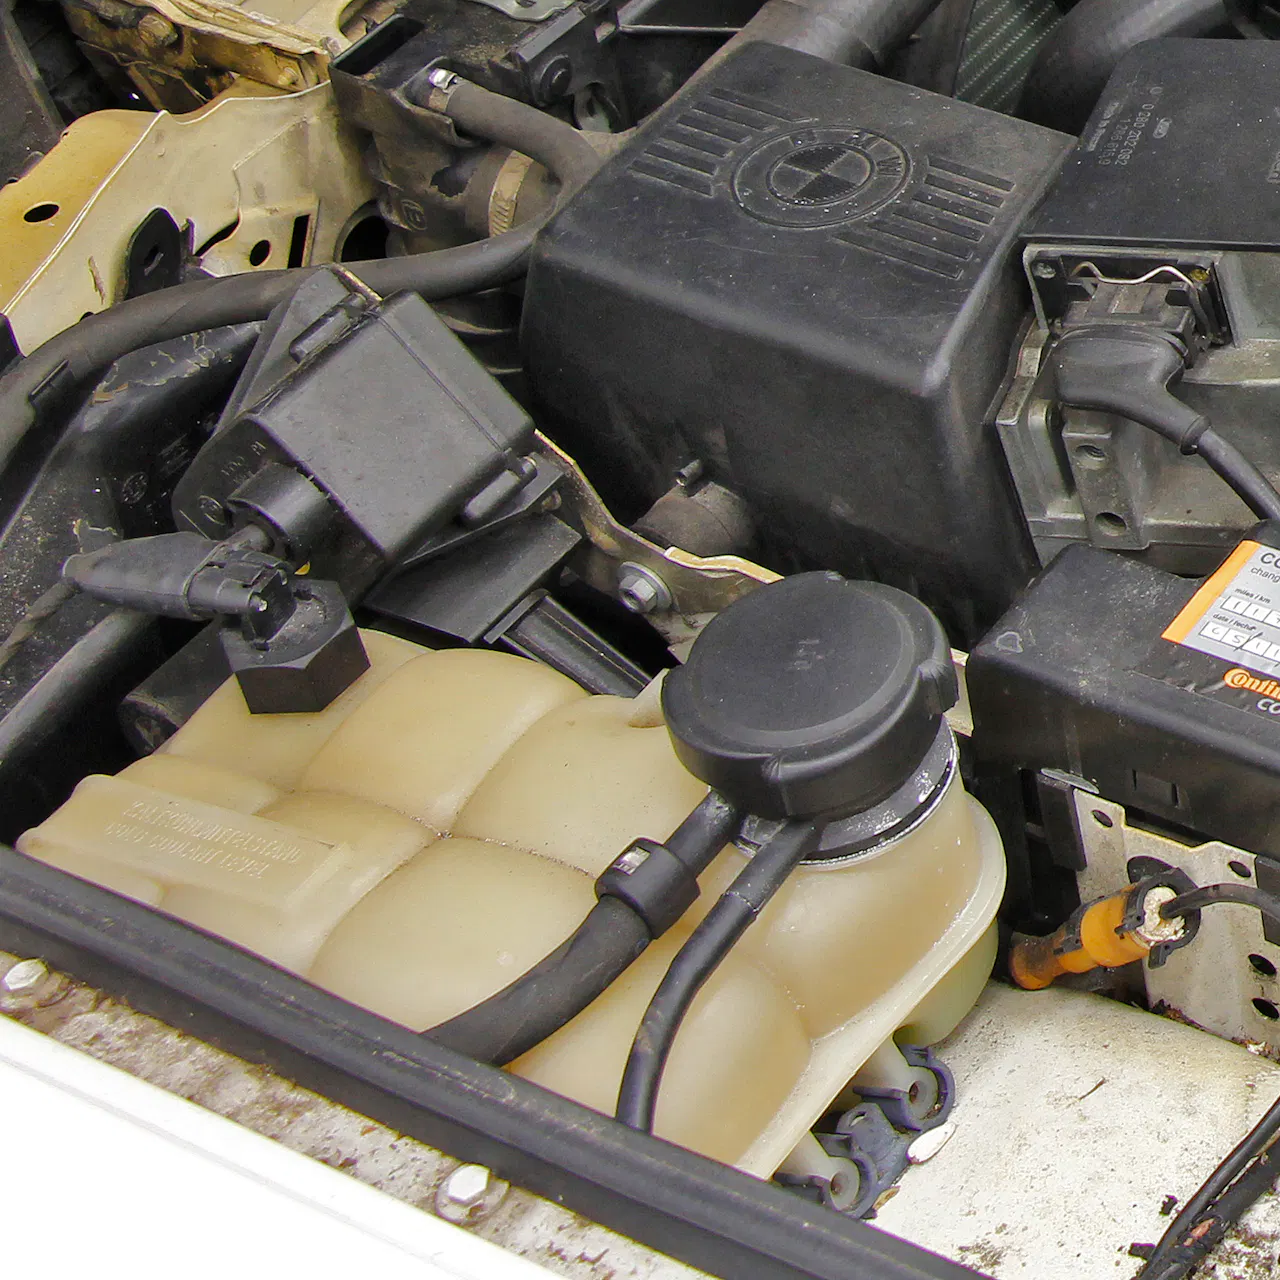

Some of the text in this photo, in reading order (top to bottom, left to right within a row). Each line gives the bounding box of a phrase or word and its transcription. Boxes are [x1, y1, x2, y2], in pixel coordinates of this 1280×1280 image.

[1235, 587, 1254, 599] miles
[1260, 595, 1271, 604] km
[1212, 613, 1228, 623] date
